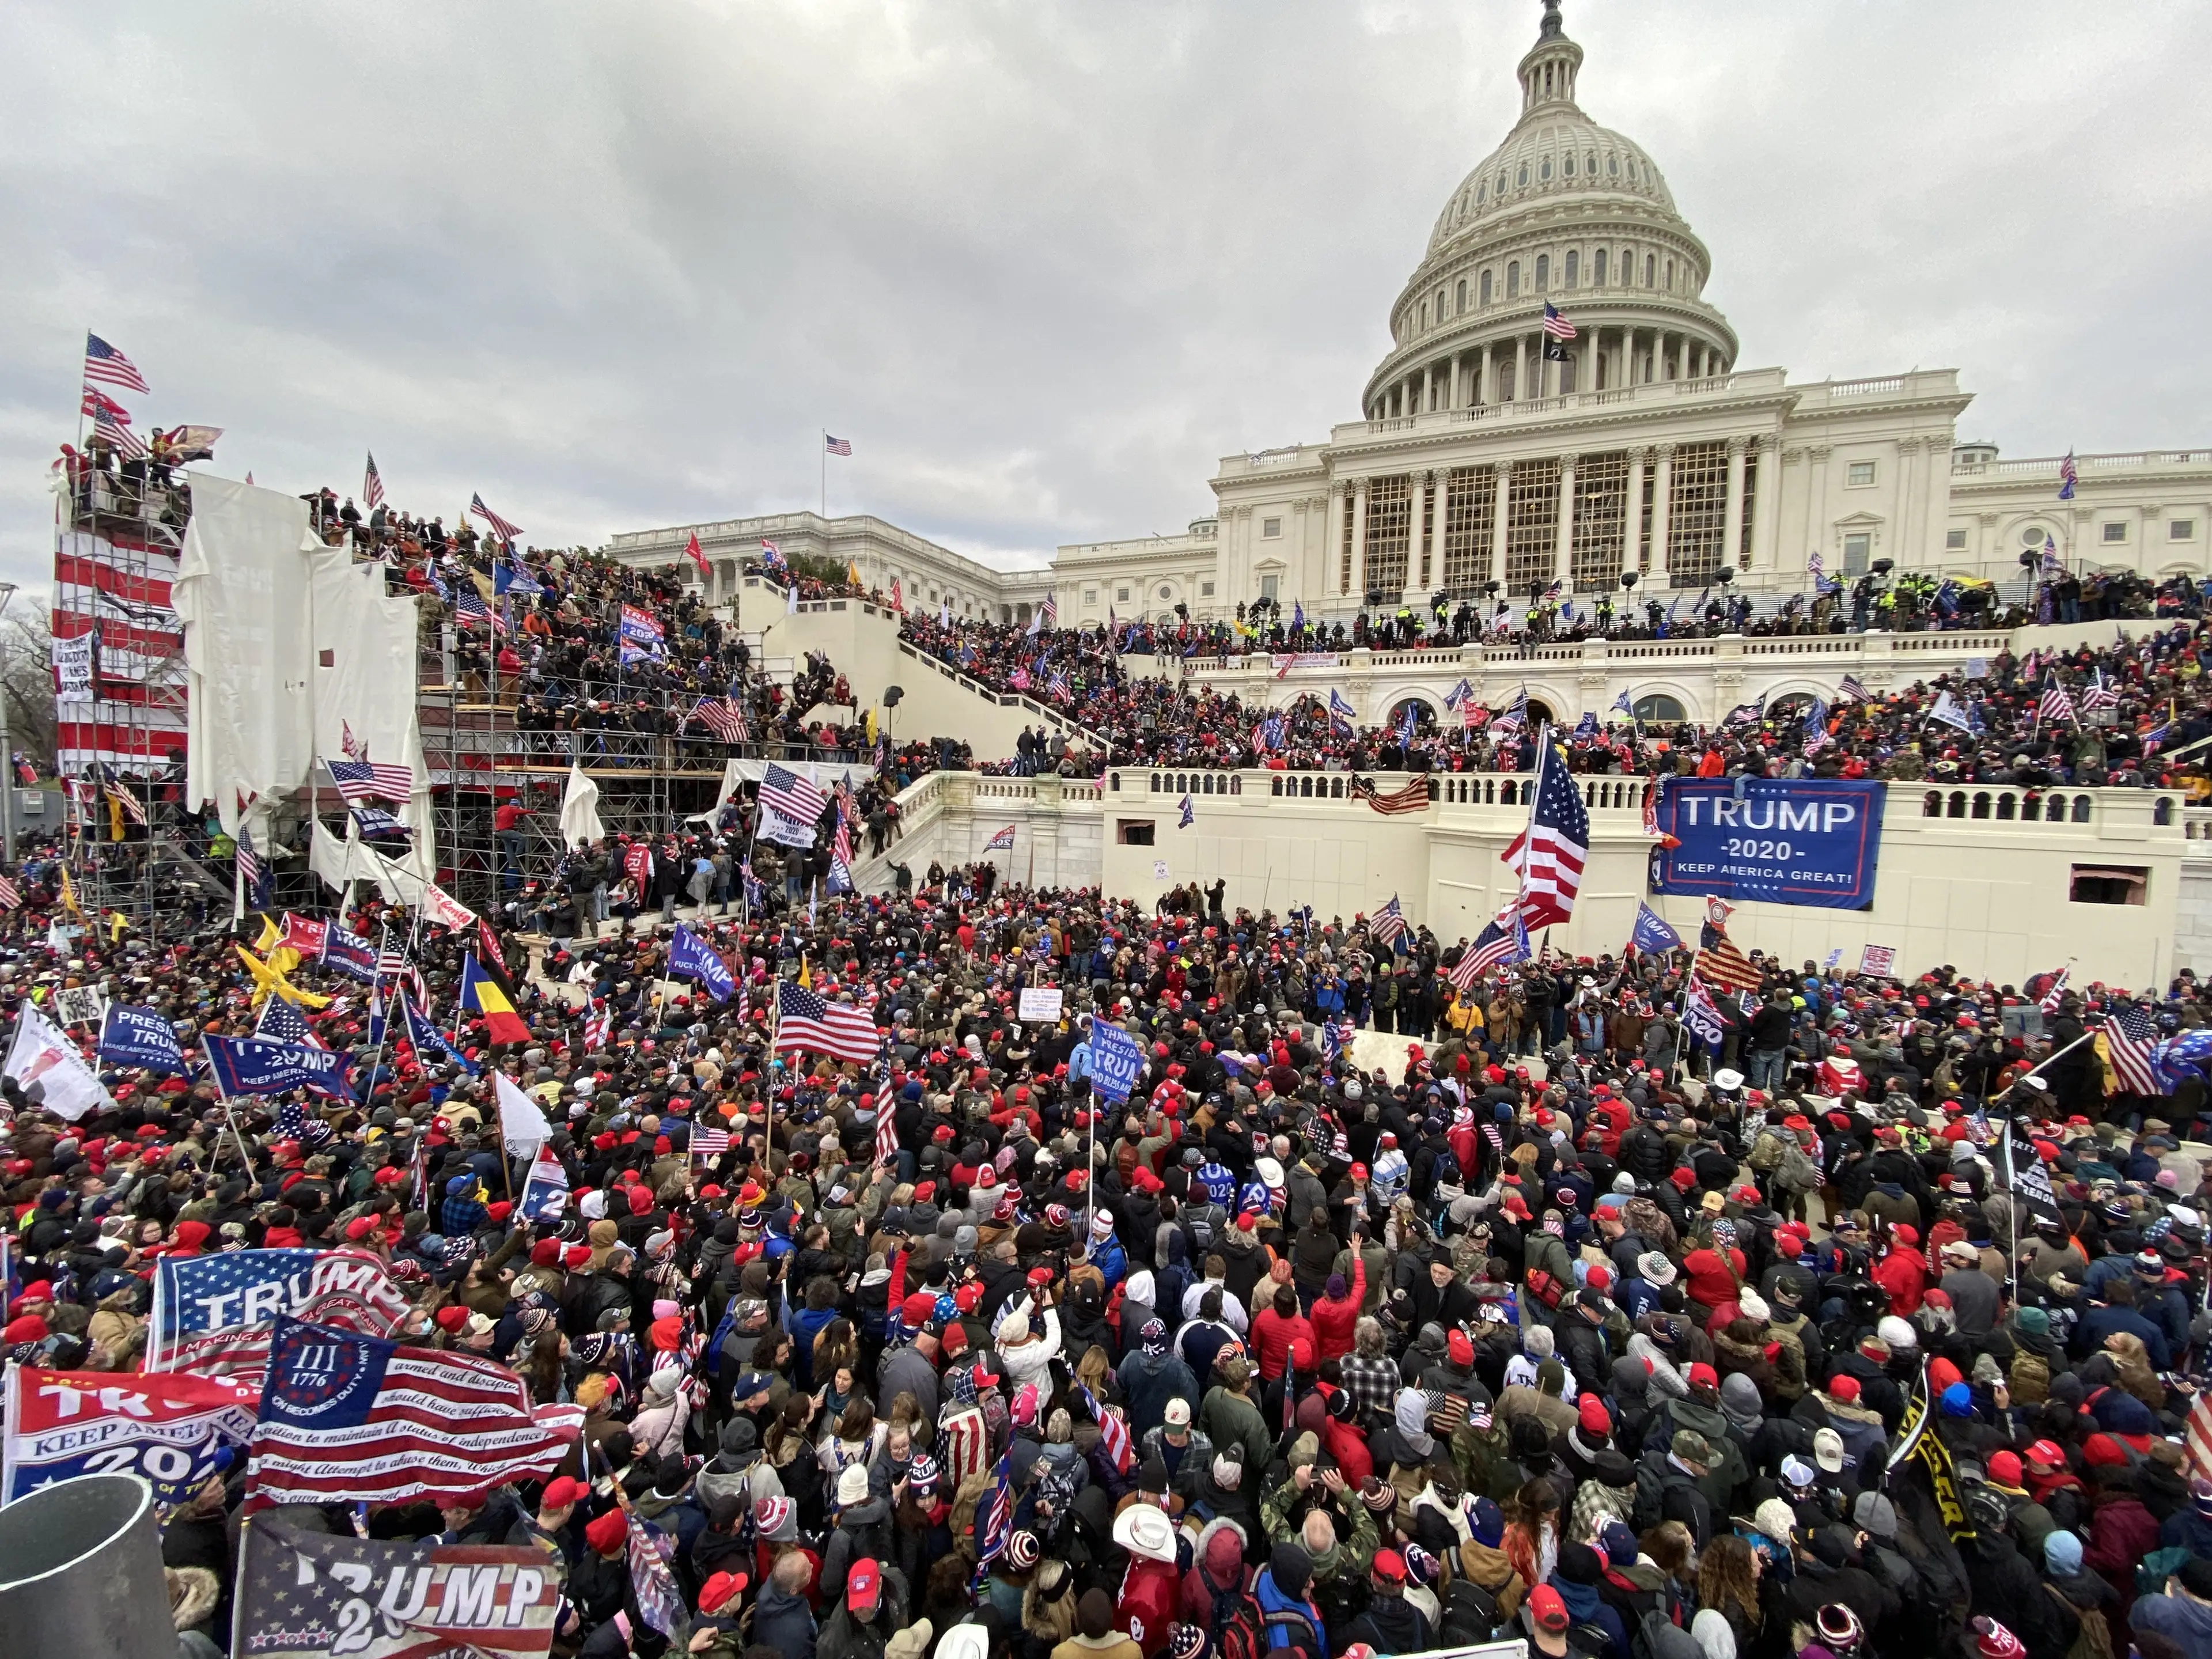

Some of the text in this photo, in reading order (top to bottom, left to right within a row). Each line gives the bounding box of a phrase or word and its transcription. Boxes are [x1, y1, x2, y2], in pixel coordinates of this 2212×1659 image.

[1680, 796, 1855, 834] TRUMP
[785, 825, 800, 836] 2020
[1678, 863, 1852, 884] KEEP AMERICA GREAT!
[328, 955, 341, 963] NO
[674, 960, 694, 969] FUCK
[56, 988, 93, 1002] FUCK
[66, 999, 93, 1007] THE
[66, 1006, 99, 1021] NWO
[104, 1042, 127, 1052] MAKE
[127, 1046, 162, 1056] AMERICA
[242, 1074, 271, 1085] KEEP
[1103, 1074, 1120, 1090] BLESS
[2010, 1139, 2037, 1154] ERTY
[1209, 1181, 1232, 1198] 020
[195, 1260, 406, 1330] TRUMP
[185, 1331, 254, 1352] MAKING
[314, 1298, 351, 1318] GREAT
[351, 1305, 381, 1335] AGAIN!
[292, 1344, 339, 1372] III
[289, 1372, 329, 1388] 1776
[394, 1362, 440, 1376] armed
[440, 1369, 466, 1381] and
[285, 1373, 363, 1416] BECOMES DUTY
[381, 1392, 426, 1408] should
[427, 1397, 457, 1415] have
[33, 1423, 118, 1456] KEEP
[305, 1433, 319, 1443] to
[323, 1426, 382, 1443] maintain
[385, 1421, 399, 1434] A
[400, 1421, 438, 1439] status
[441, 1435, 457, 1444] of
[458, 1431, 542, 1449] independence
[272, 1449, 507, 1476] might Attempt to abuse them, Which
